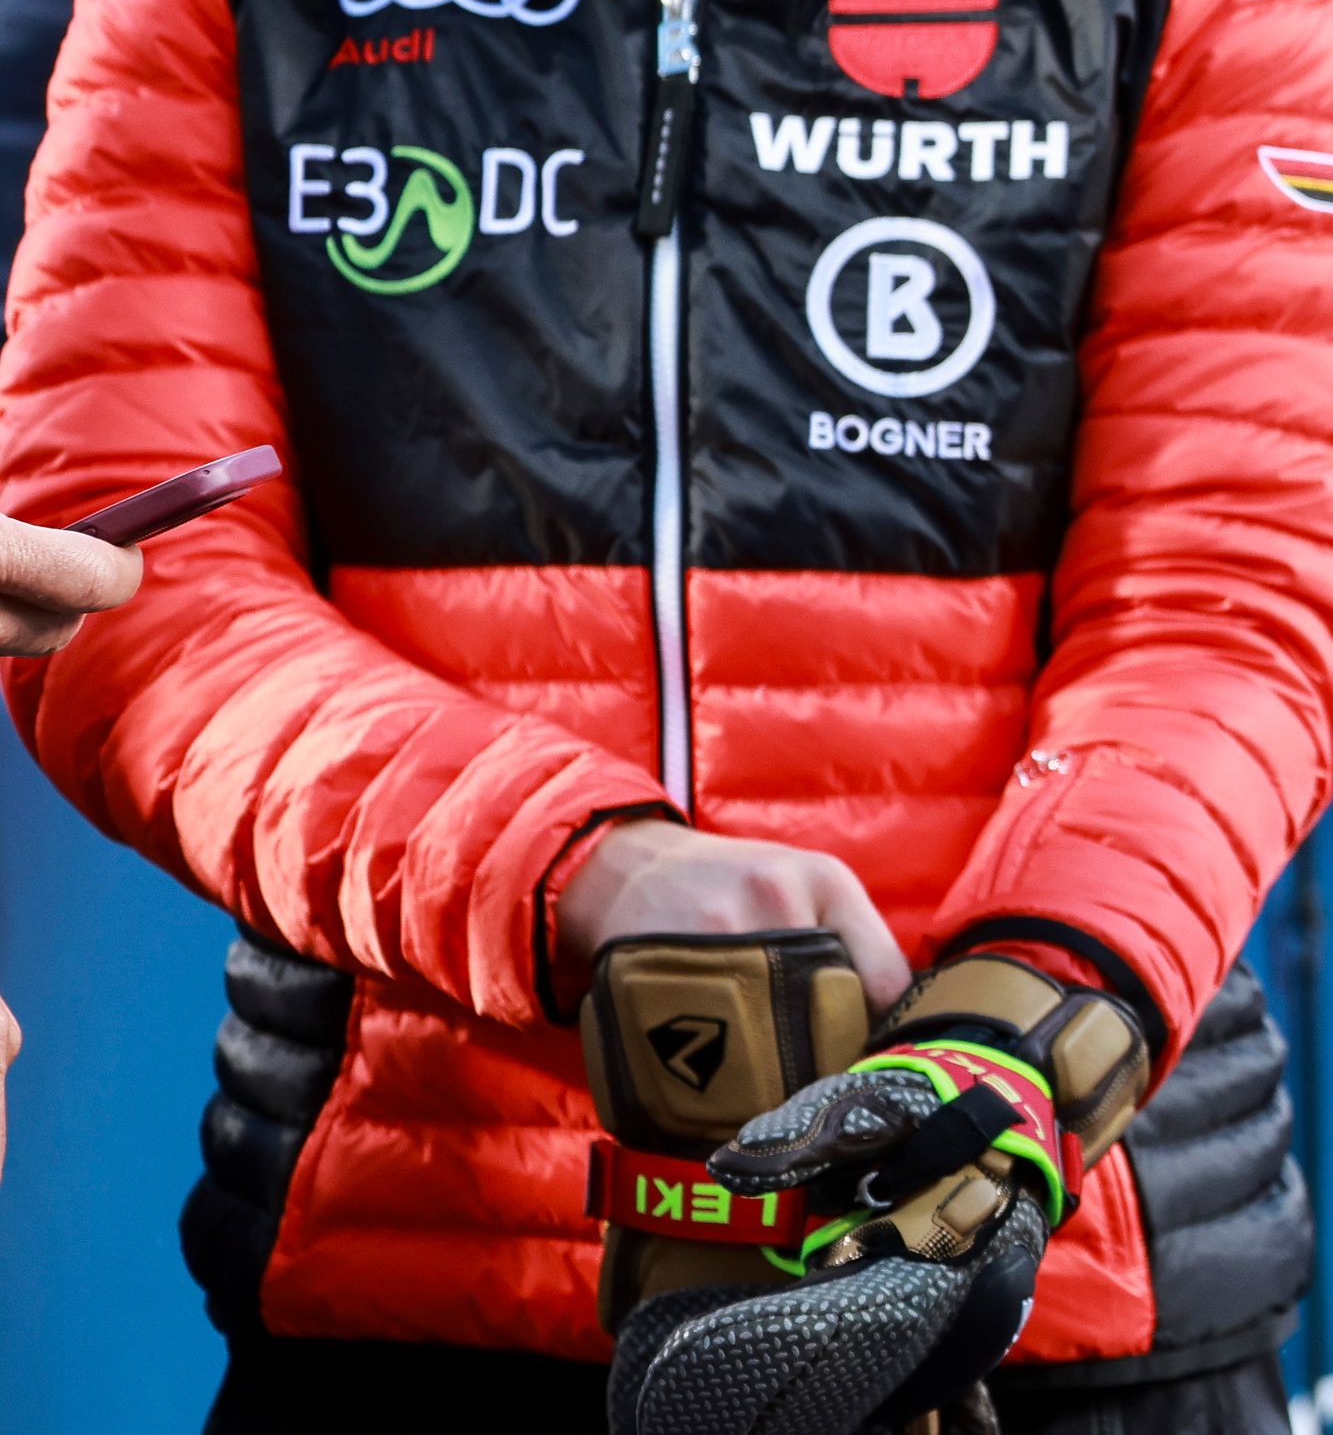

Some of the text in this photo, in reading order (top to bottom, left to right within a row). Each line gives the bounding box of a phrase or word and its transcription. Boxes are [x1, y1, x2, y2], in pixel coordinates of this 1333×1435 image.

[328, 27, 437, 70] Audi
[808, 411, 993, 461] BOGNER
[634, 1173, 778, 1226] LEKI
